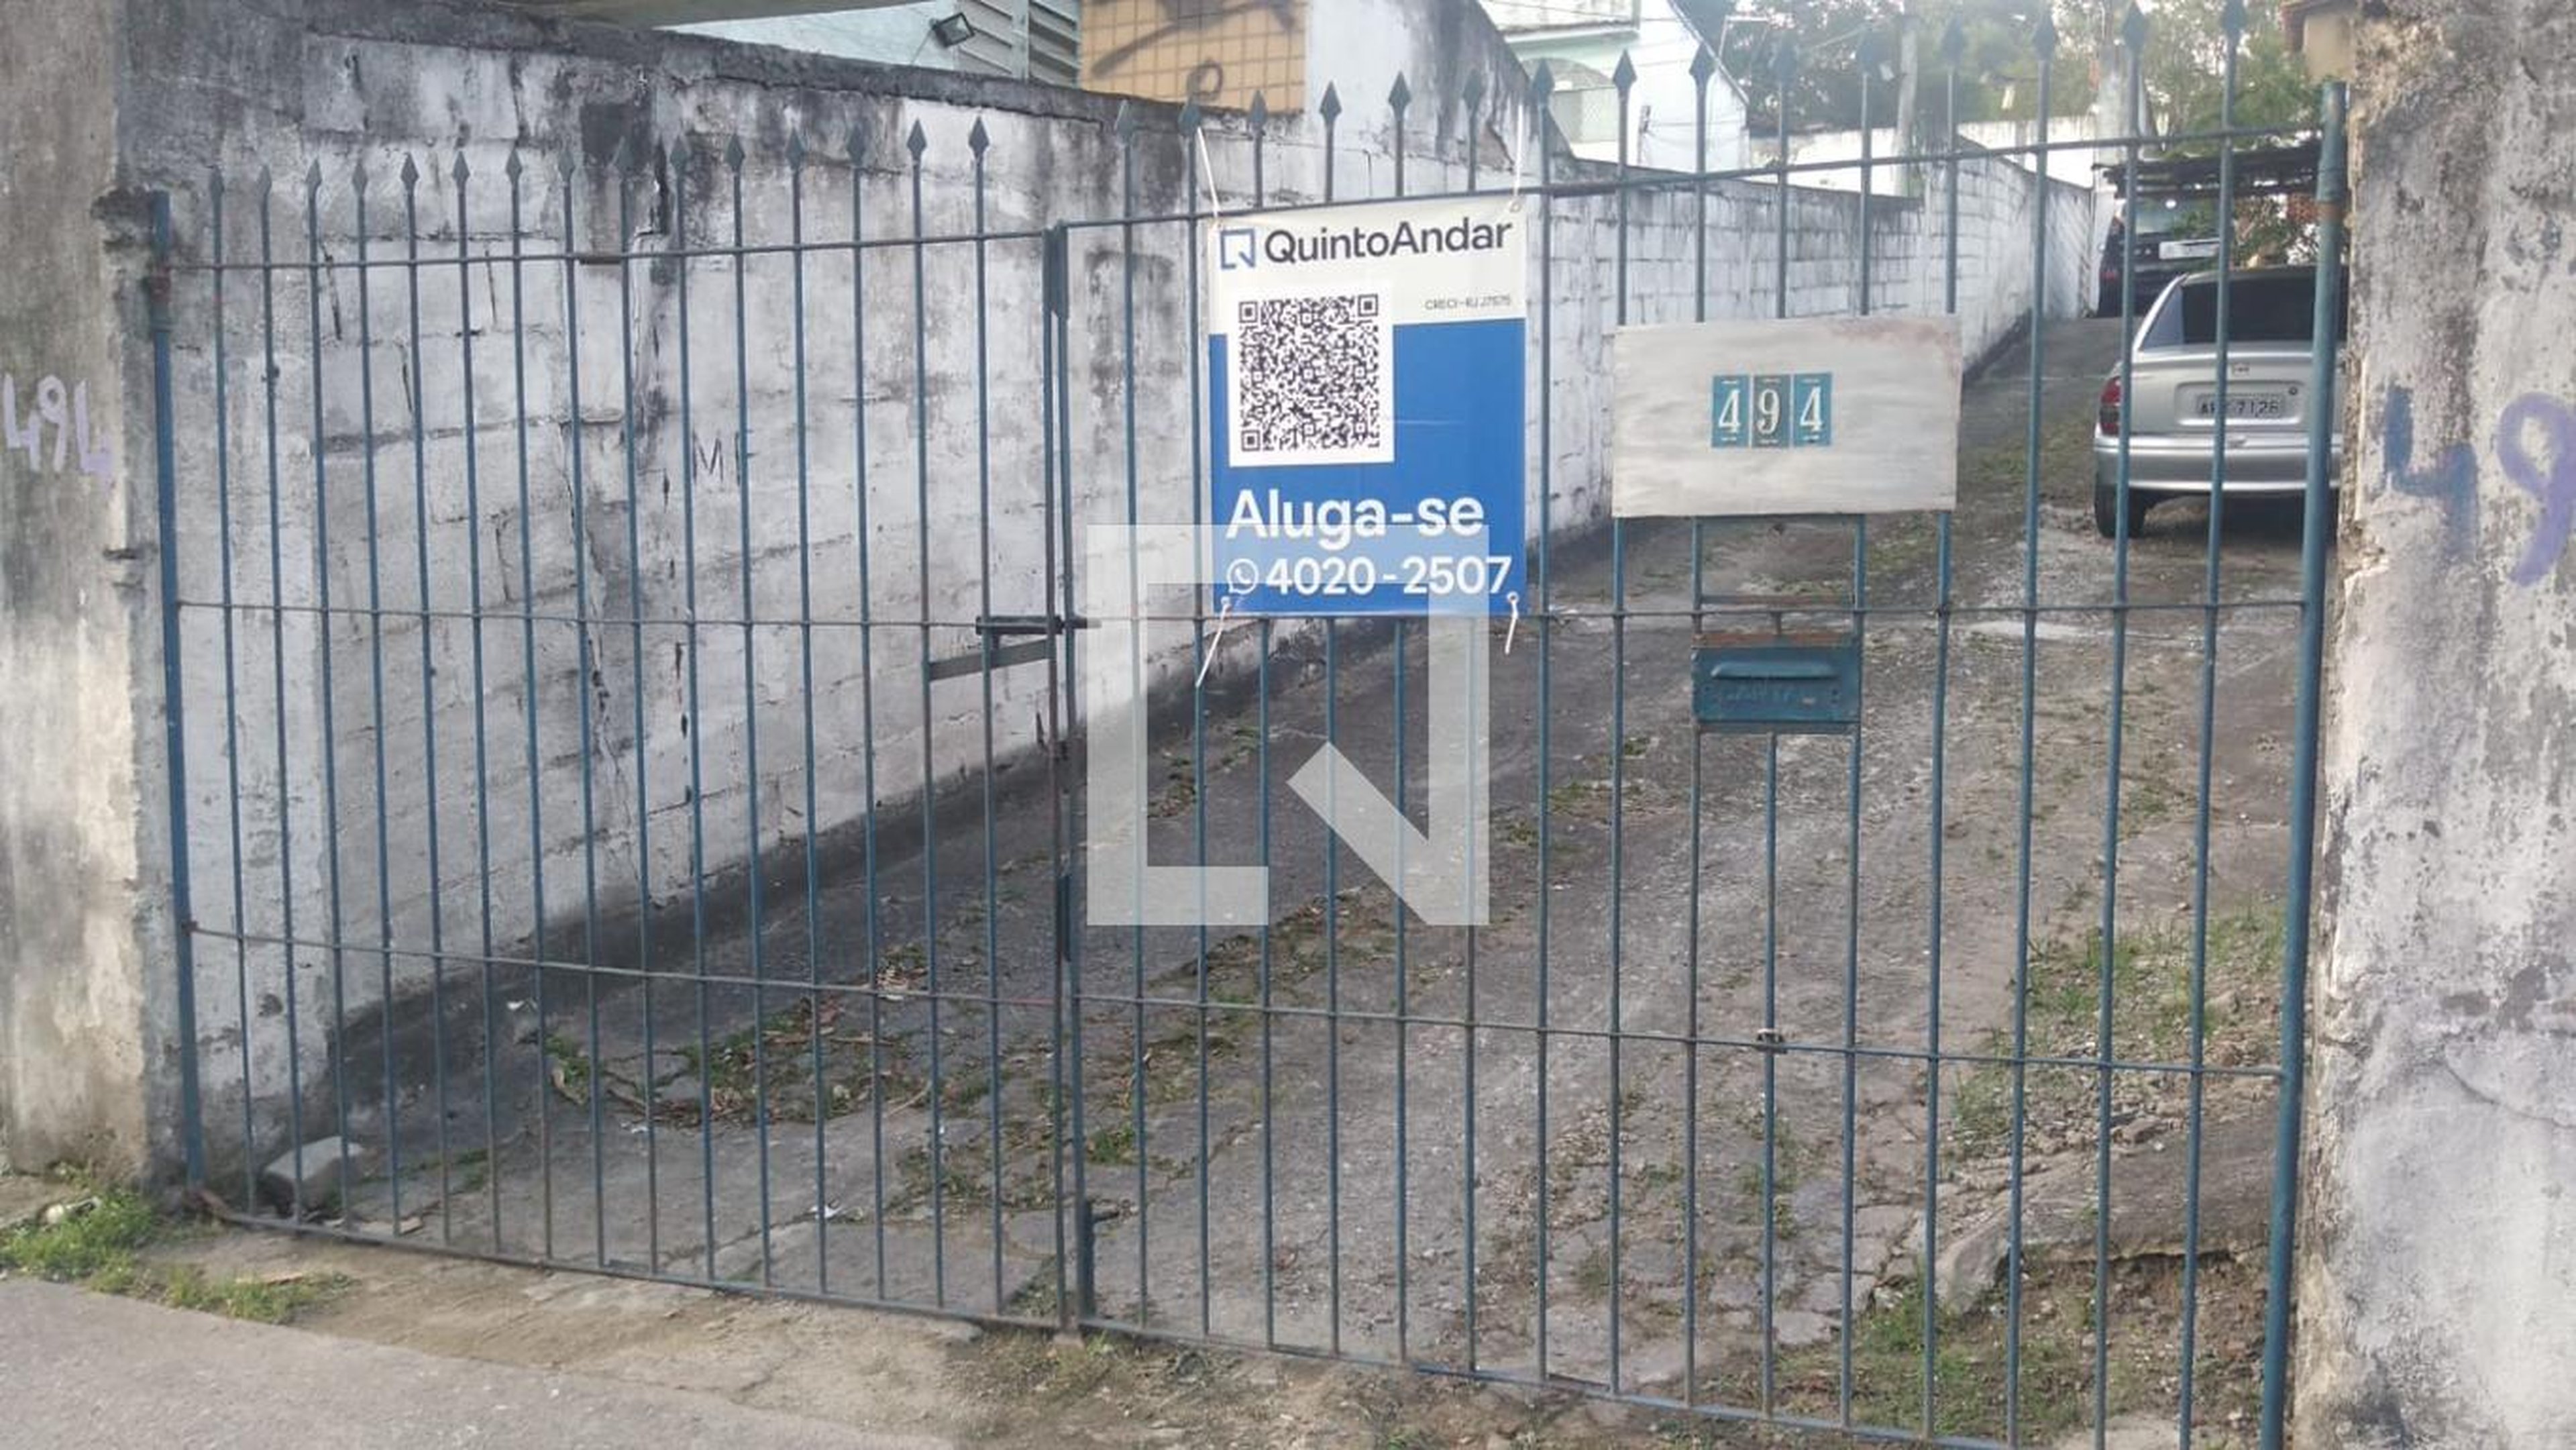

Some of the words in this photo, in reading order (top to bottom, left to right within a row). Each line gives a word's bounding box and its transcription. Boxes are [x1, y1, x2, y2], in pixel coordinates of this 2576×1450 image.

[1265, 219, 1513, 264] QuintoAndar
[1717, 386, 1824, 435] 494
[1226, 488, 1485, 550] Aluga-se
